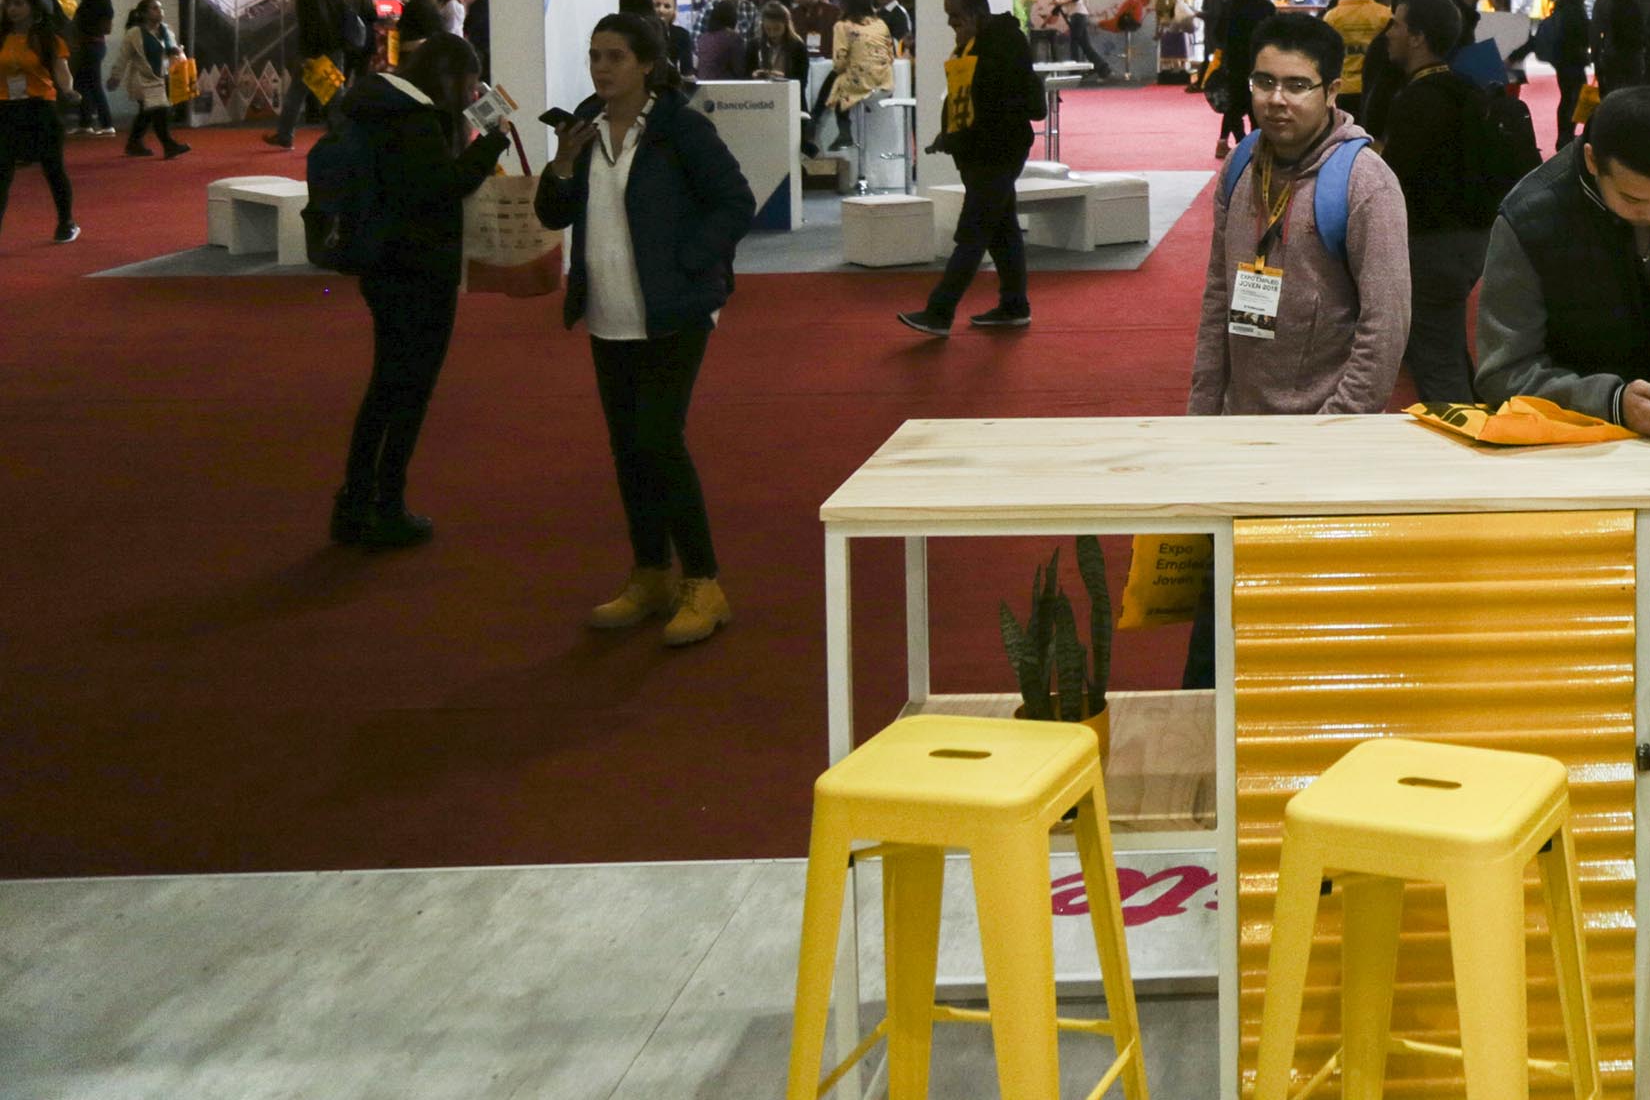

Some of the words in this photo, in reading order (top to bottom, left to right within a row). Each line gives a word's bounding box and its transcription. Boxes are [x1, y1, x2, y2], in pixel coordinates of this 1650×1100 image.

[716, 100, 775, 110] BancoCiudad
[1159, 543, 1193, 556] Expo
[1152, 575, 1193, 586] Joven
